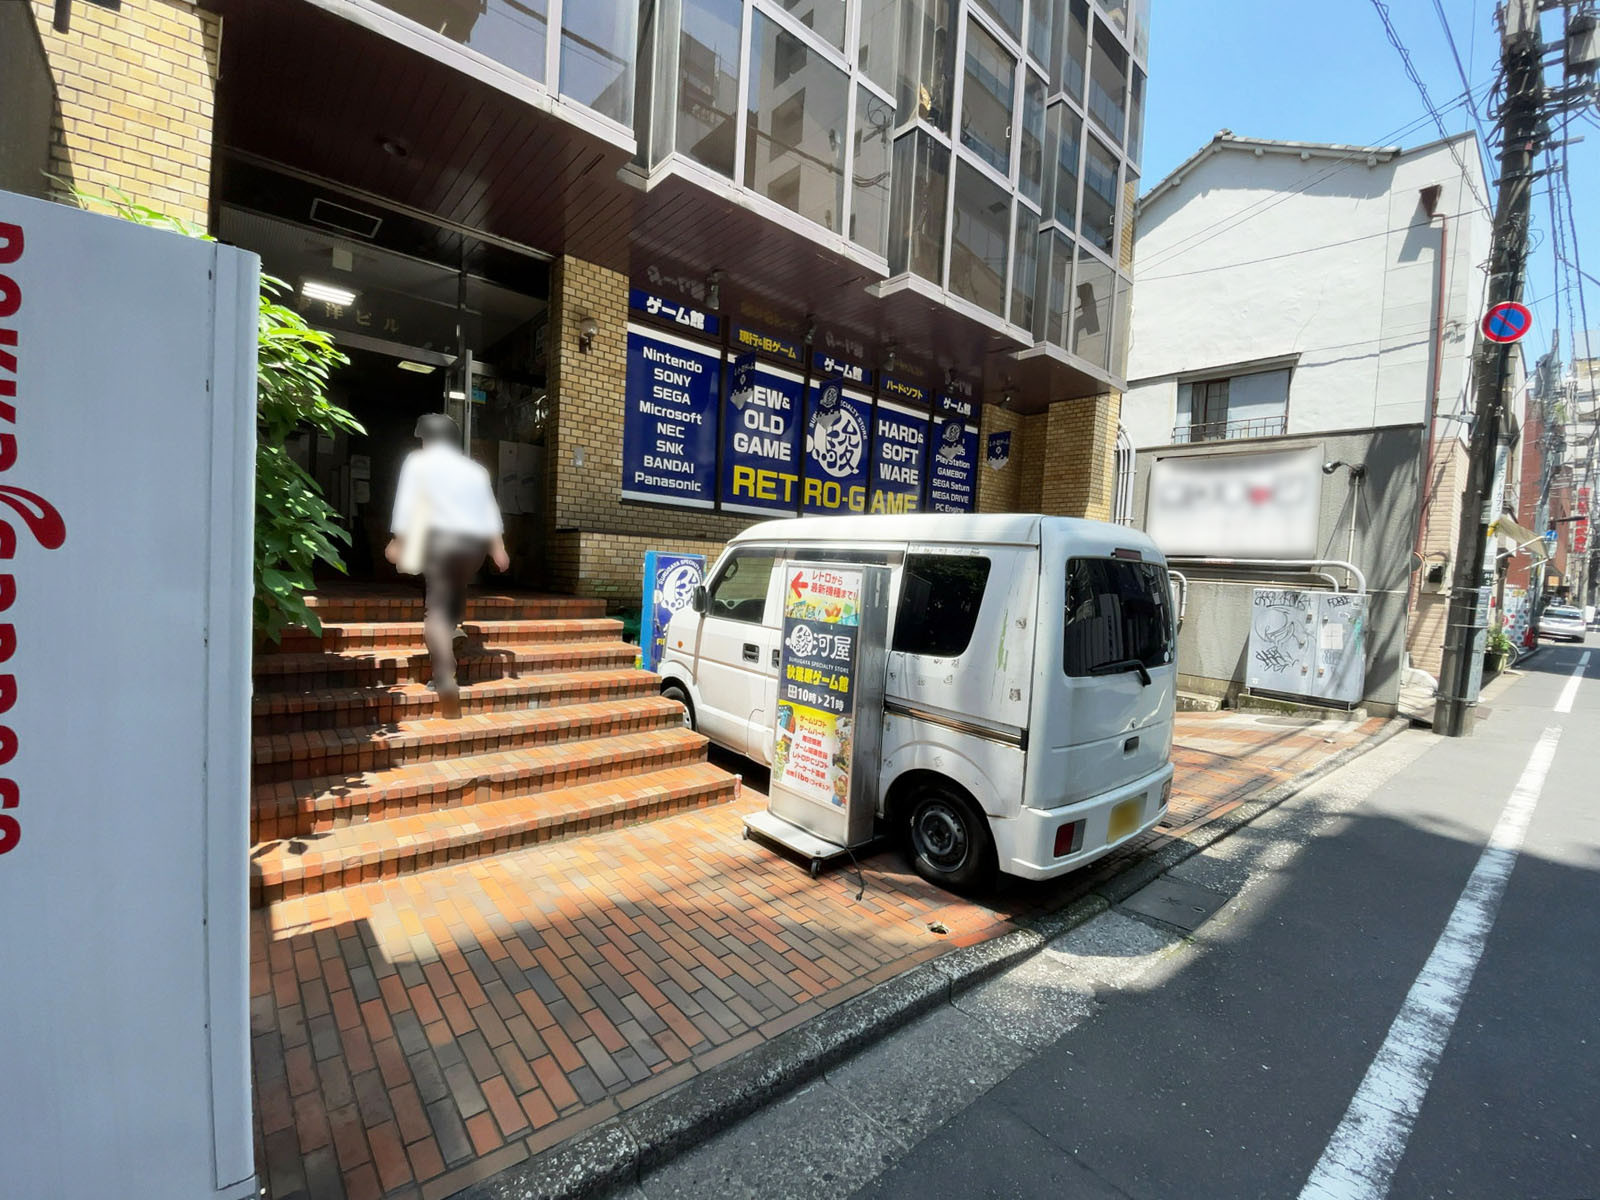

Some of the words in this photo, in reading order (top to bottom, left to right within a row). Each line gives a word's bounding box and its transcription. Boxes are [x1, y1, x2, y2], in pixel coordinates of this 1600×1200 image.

[646, 296, 705, 330] ゲーム館
[643, 346, 703, 374] Nintendo
[824, 357, 863, 381] ゲーム館
[654, 368, 692, 387] SONY
[653, 385, 691, 405] SEGA
[639, 400, 702, 425] Microsoft
[943, 397, 971, 416] ゲーム館
[656, 422, 685, 438] NEC
[744, 409, 785, 435] OLD
[656, 440, 684, 455] SNK
[733, 432, 791, 461] GAME
[882, 442, 918, 465] SOFT
[643, 454, 695, 474] BANDAI
[935, 454, 971, 469] PlayStation
[634, 471, 702, 492] Panasonic
[879, 463, 919, 485] WARE
[937, 467, 967, 480] GAMEBOY
[932, 478, 950, 489] SEGA
[950, 481, 970, 492] Saturn
[932, 490, 950, 500] MEGA
[950, 494, 969, 503] DRIVE
[935, 502, 945, 512] PC
[945, 503, 965, 514] Engine
[812, 570, 843, 585] レトロから
[811, 660, 834, 671] SPECIALTY
[834, 665, 849, 673] STORE
[797, 687, 817, 704] 10時
[823, 694, 844, 711] 21時
